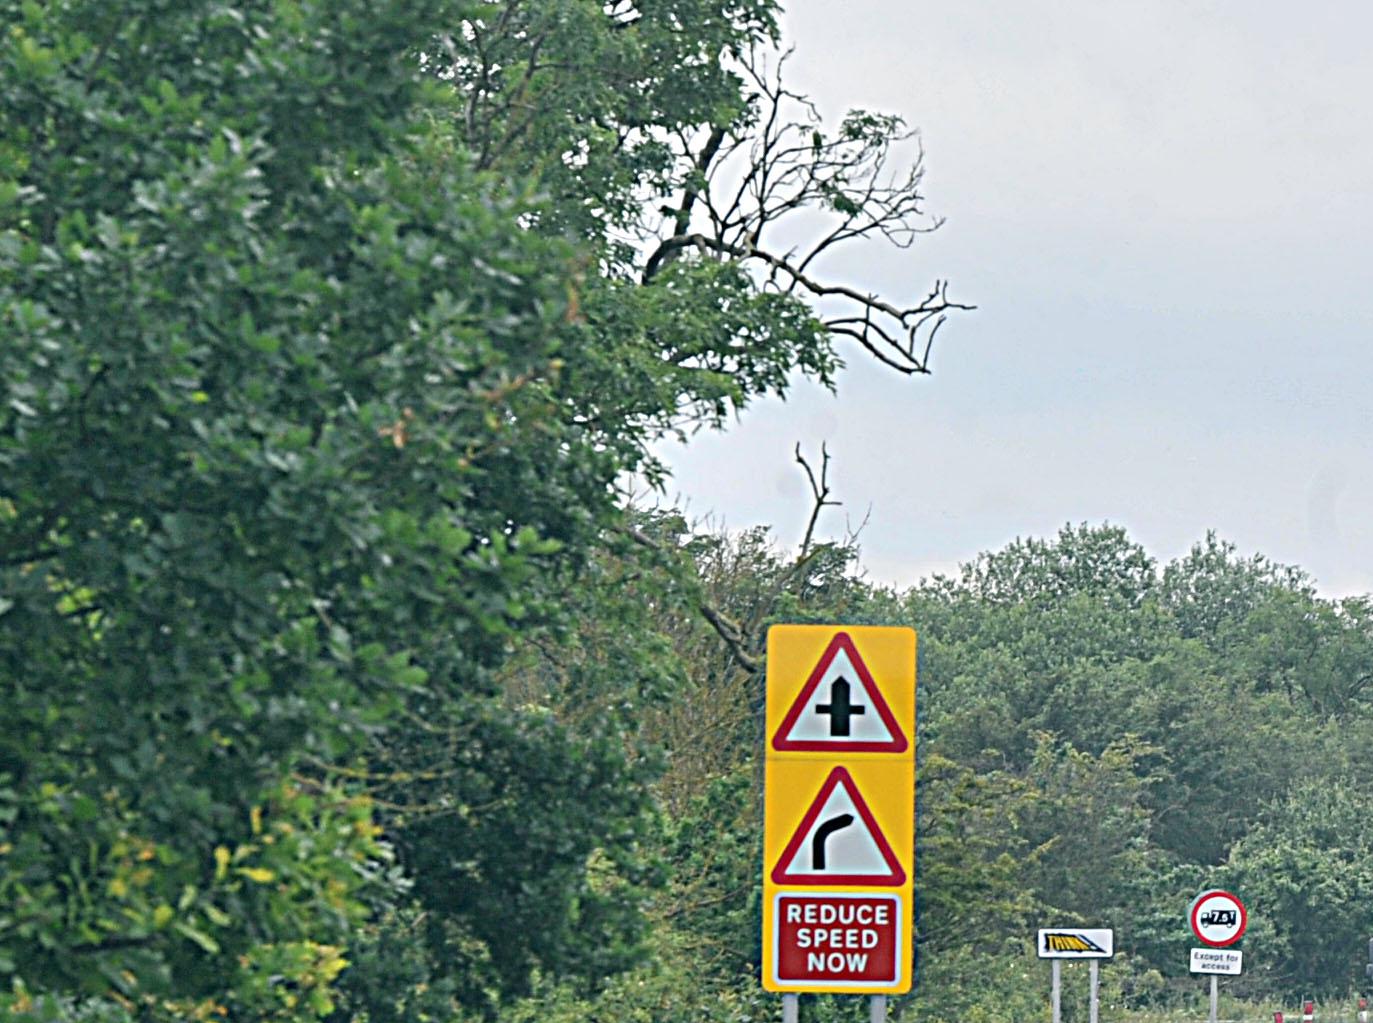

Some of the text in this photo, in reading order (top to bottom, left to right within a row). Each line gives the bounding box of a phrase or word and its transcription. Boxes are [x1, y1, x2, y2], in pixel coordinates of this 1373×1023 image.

[786, 904, 889, 925] REDUCE
[796, 928, 879, 949] SPEED
[807, 952, 868, 972] NOW
[1194, 952, 1239, 962] Except for
[1200, 963, 1231, 971] access
